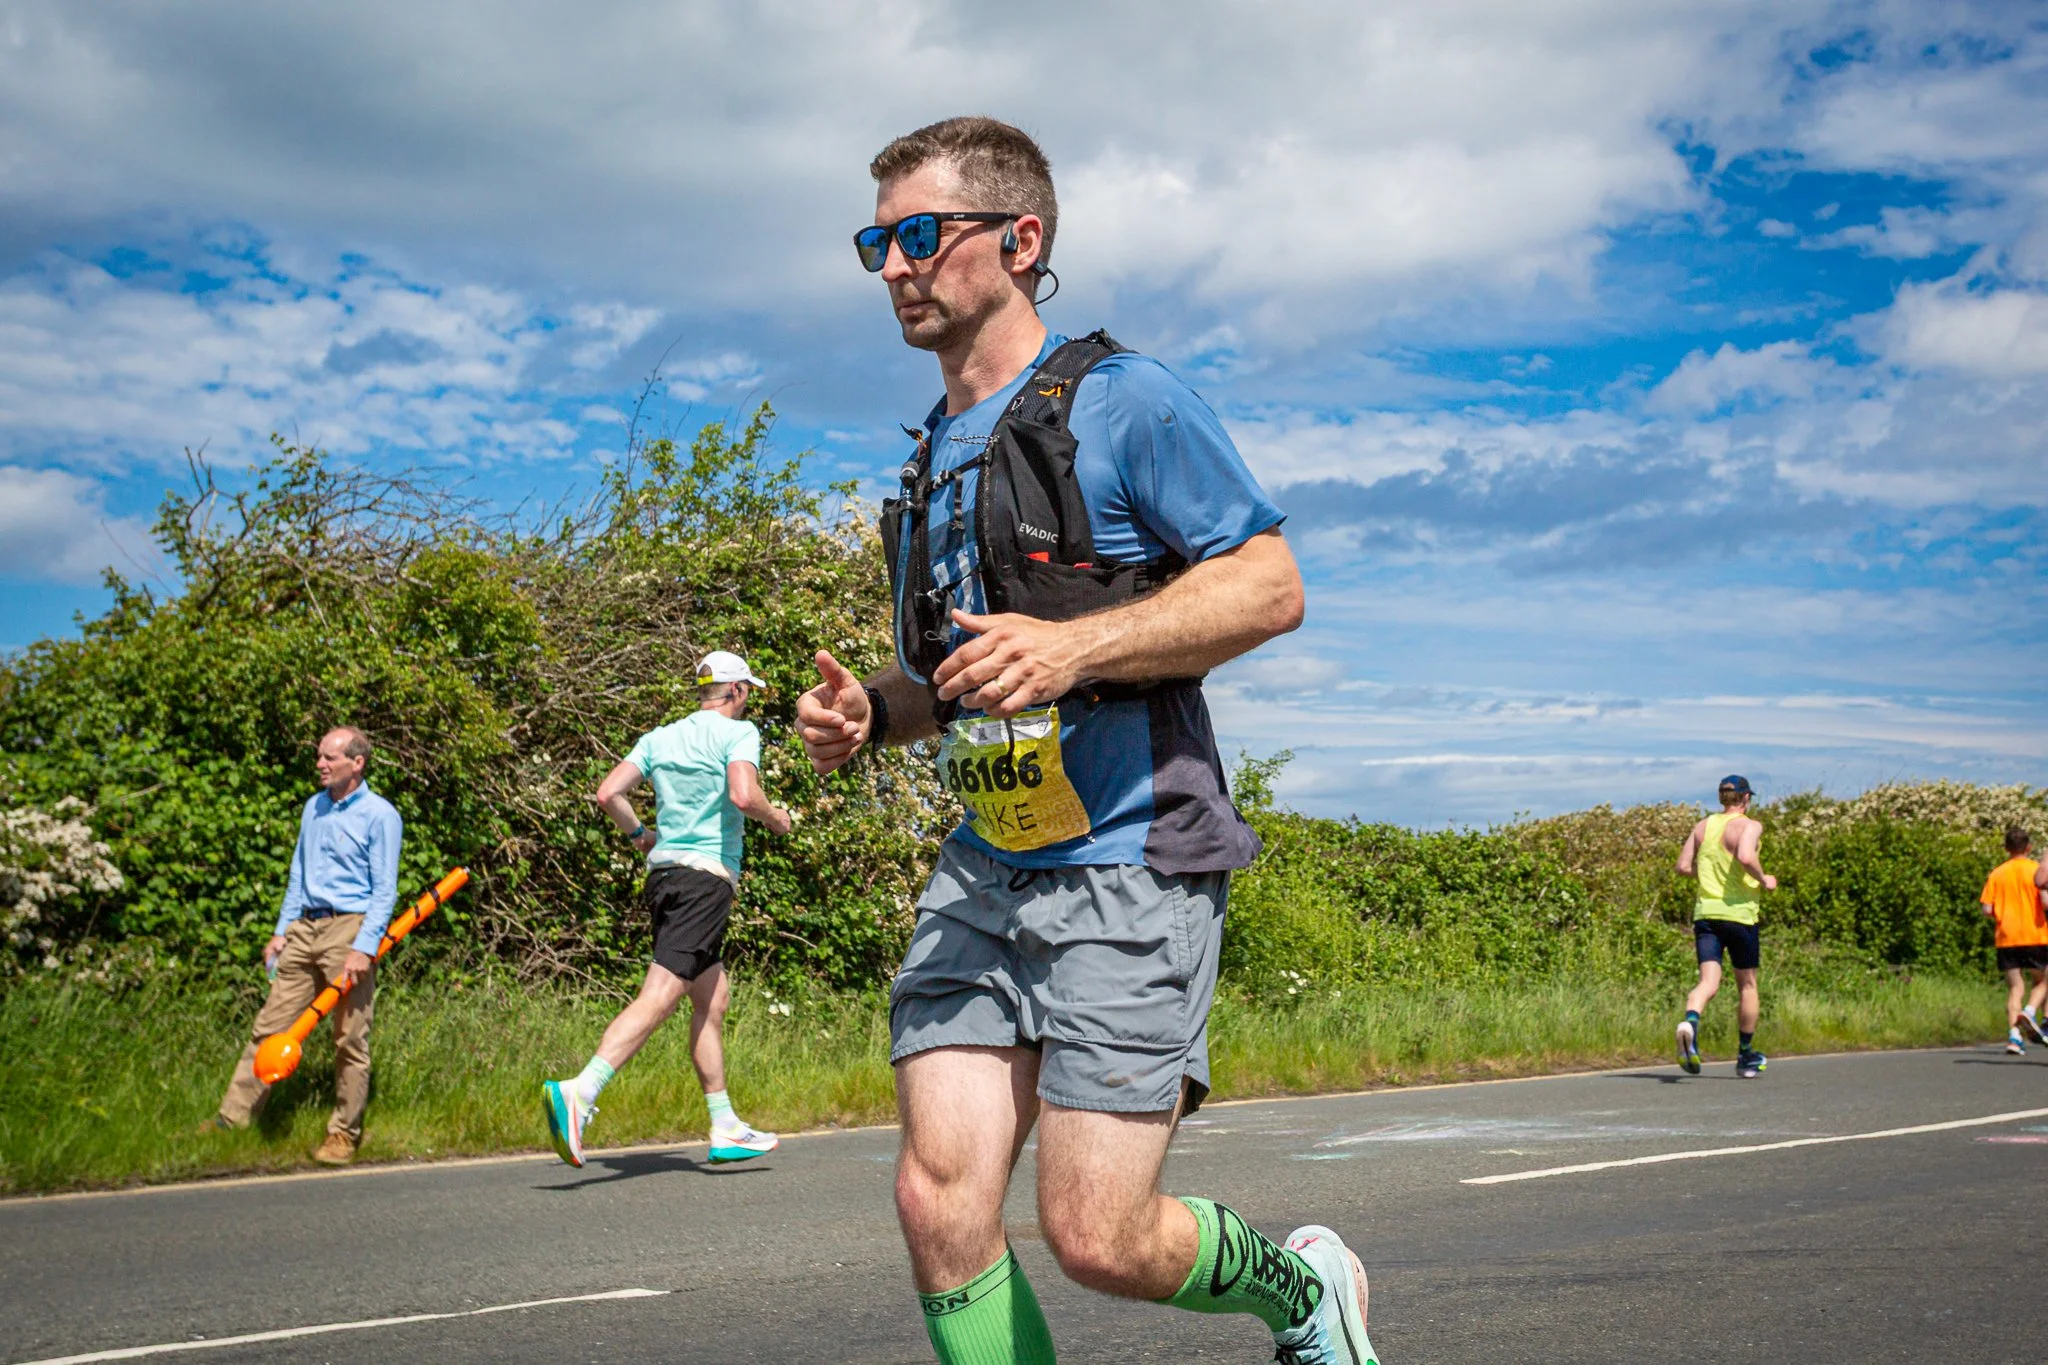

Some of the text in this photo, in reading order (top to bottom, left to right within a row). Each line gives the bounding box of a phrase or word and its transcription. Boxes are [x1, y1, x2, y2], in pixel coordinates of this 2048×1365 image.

[1019, 522, 1059, 544] EVADIC
[947, 750, 1043, 793] 86166
[972, 801, 1037, 836] IKE
[922, 1291, 970, 1312] ION
